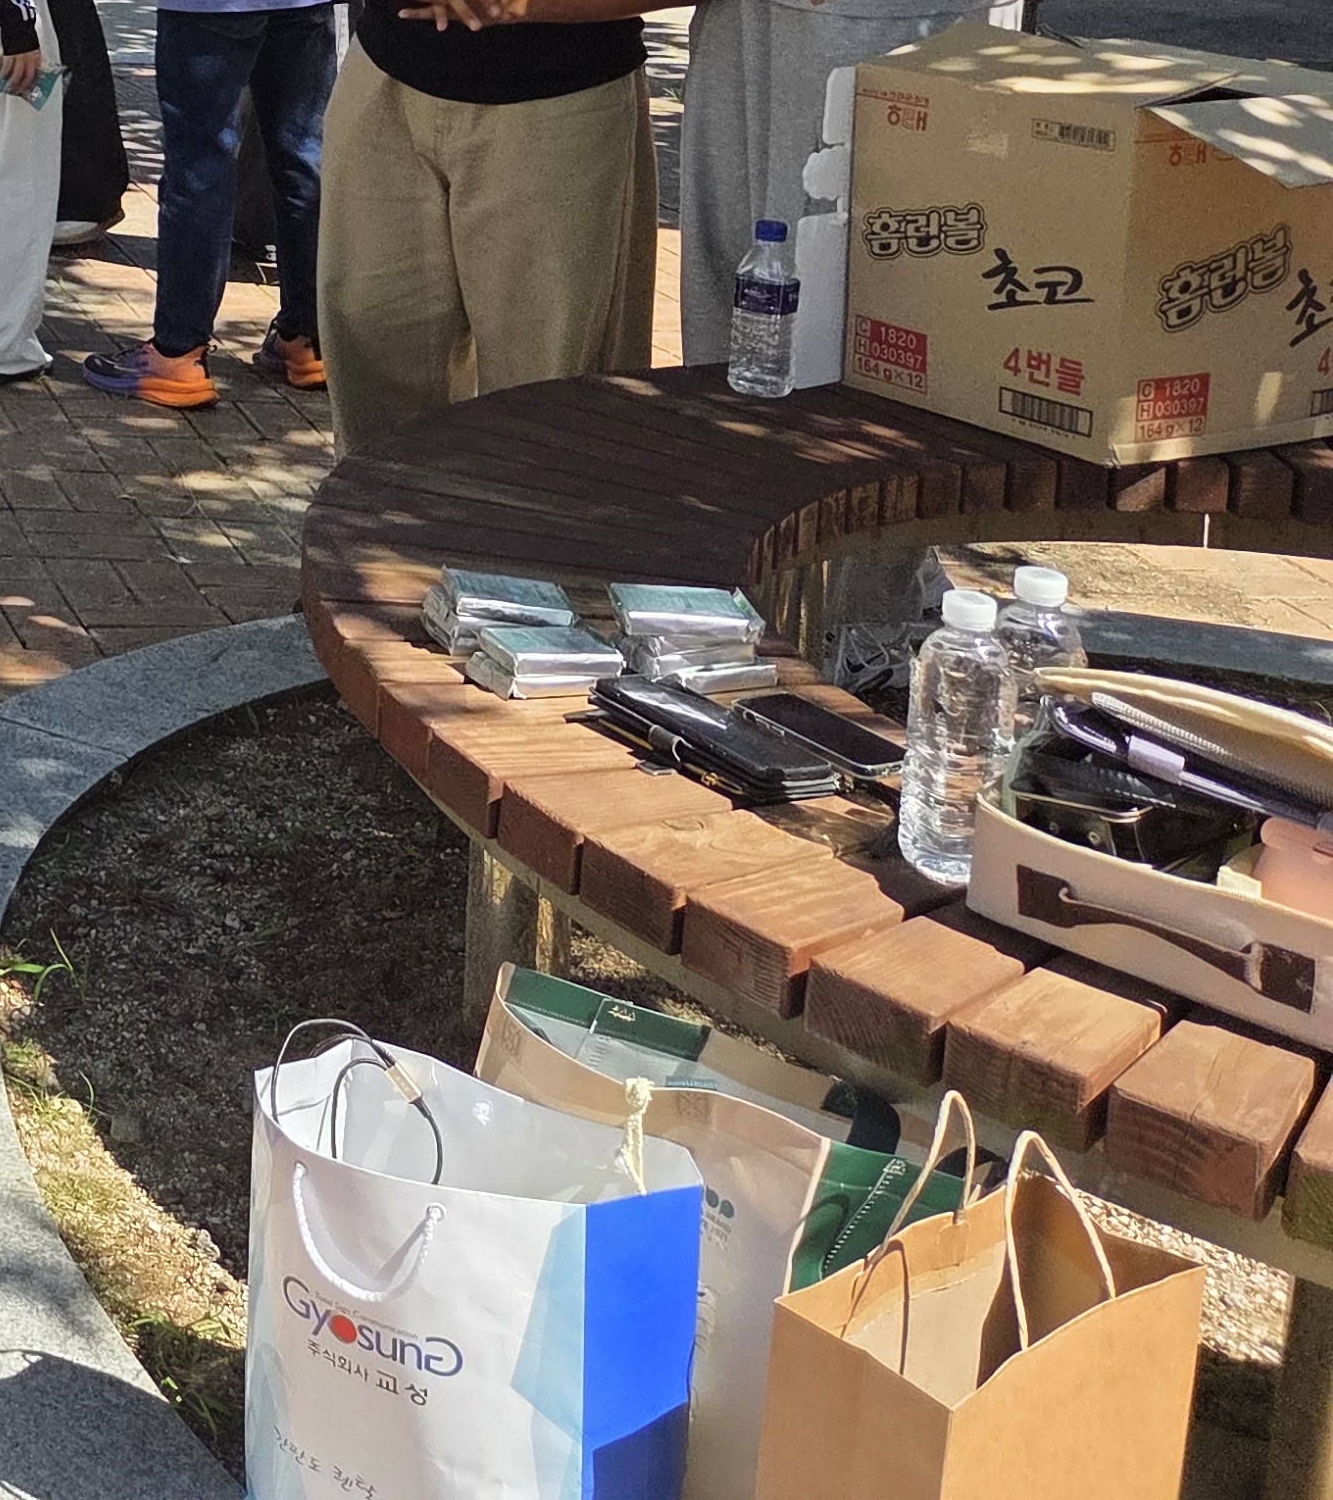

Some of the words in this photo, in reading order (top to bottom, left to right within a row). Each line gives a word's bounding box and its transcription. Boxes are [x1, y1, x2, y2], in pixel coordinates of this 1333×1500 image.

[862, 202, 988, 260] 홈런볼
[981, 248, 1094, 312] 초코
[1155, 222, 1294, 333] 홈런볼
[1286, 267, 1333, 348] 초
[871, 341, 923, 369] 030397
[879, 326, 917, 349] 1820
[1003, 347, 1085, 397] 4번들
[1164, 378, 1201, 397] 1820
[1155, 398, 1205, 417] 030397
[307, 1339, 369, 1382] 주식회사
